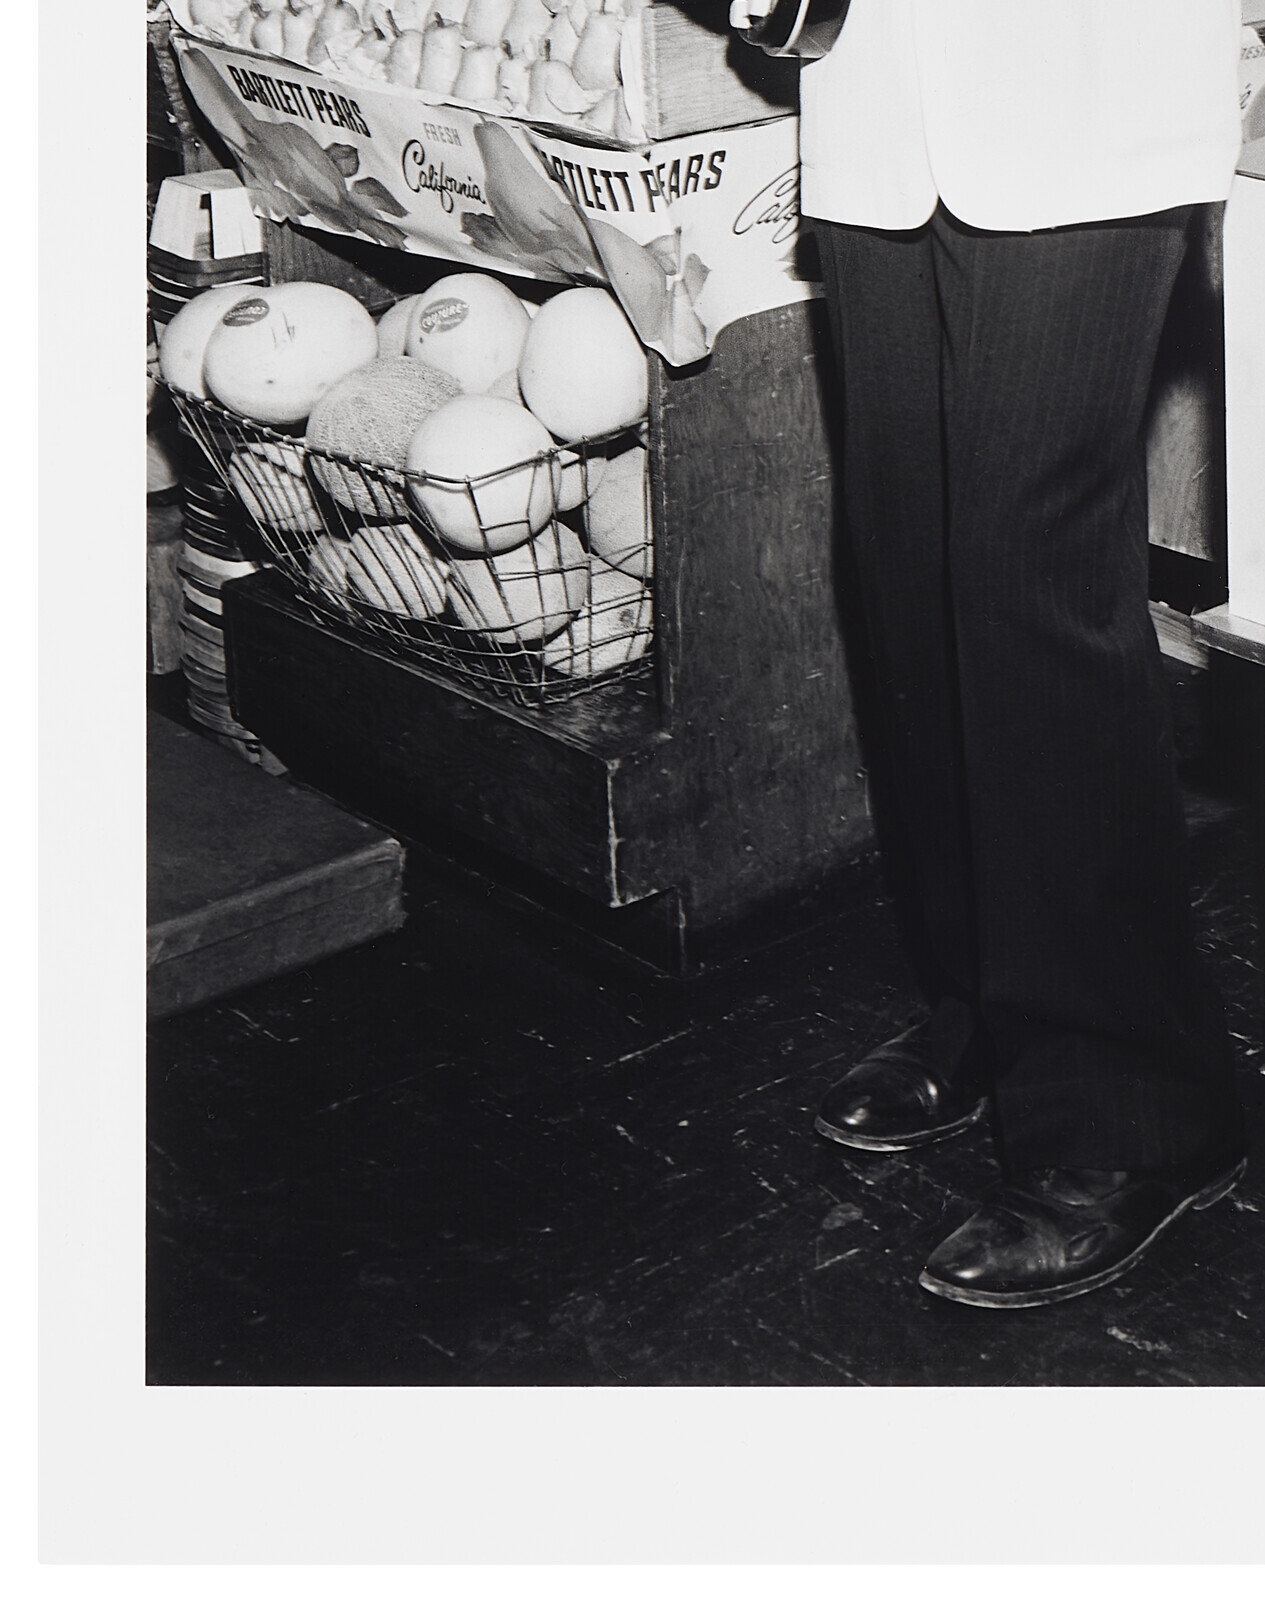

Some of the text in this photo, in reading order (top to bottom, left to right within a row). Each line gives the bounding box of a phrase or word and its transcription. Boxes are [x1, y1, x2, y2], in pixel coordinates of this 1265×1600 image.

[226, 64, 372, 139] BARTLETT PEARS
[422, 122, 463, 148] FRESH
[402, 138, 487, 214] California
